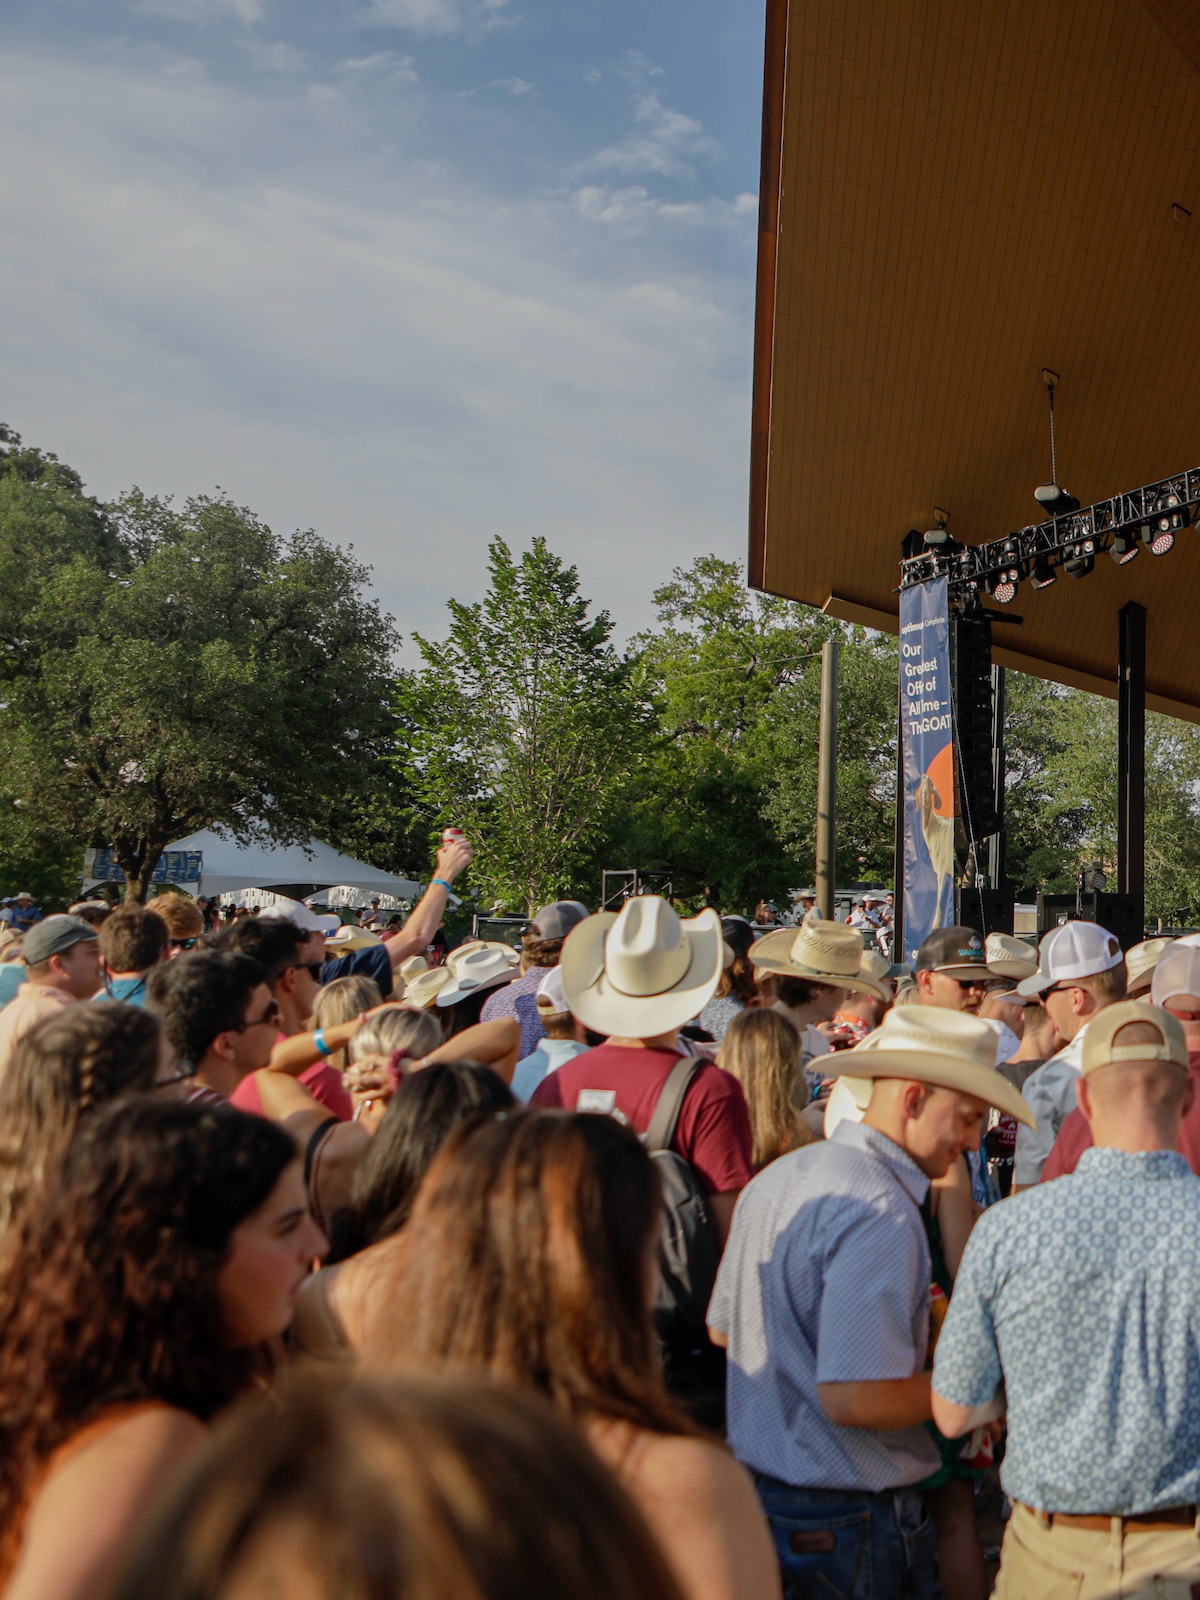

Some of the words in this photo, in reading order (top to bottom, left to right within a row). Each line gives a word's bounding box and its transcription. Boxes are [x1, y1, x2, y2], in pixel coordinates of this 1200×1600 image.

[901, 622, 924, 635] optimu
[924, 616, 945, 627] Complete
[902, 643, 922, 658] Our
[904, 657, 938, 677] Greest
[907, 680, 924, 697] Offr
[925, 676, 937, 691] of
[908, 701, 921, 717] All
[921, 699, 940, 712] ime
[909, 720, 923, 736] Th
